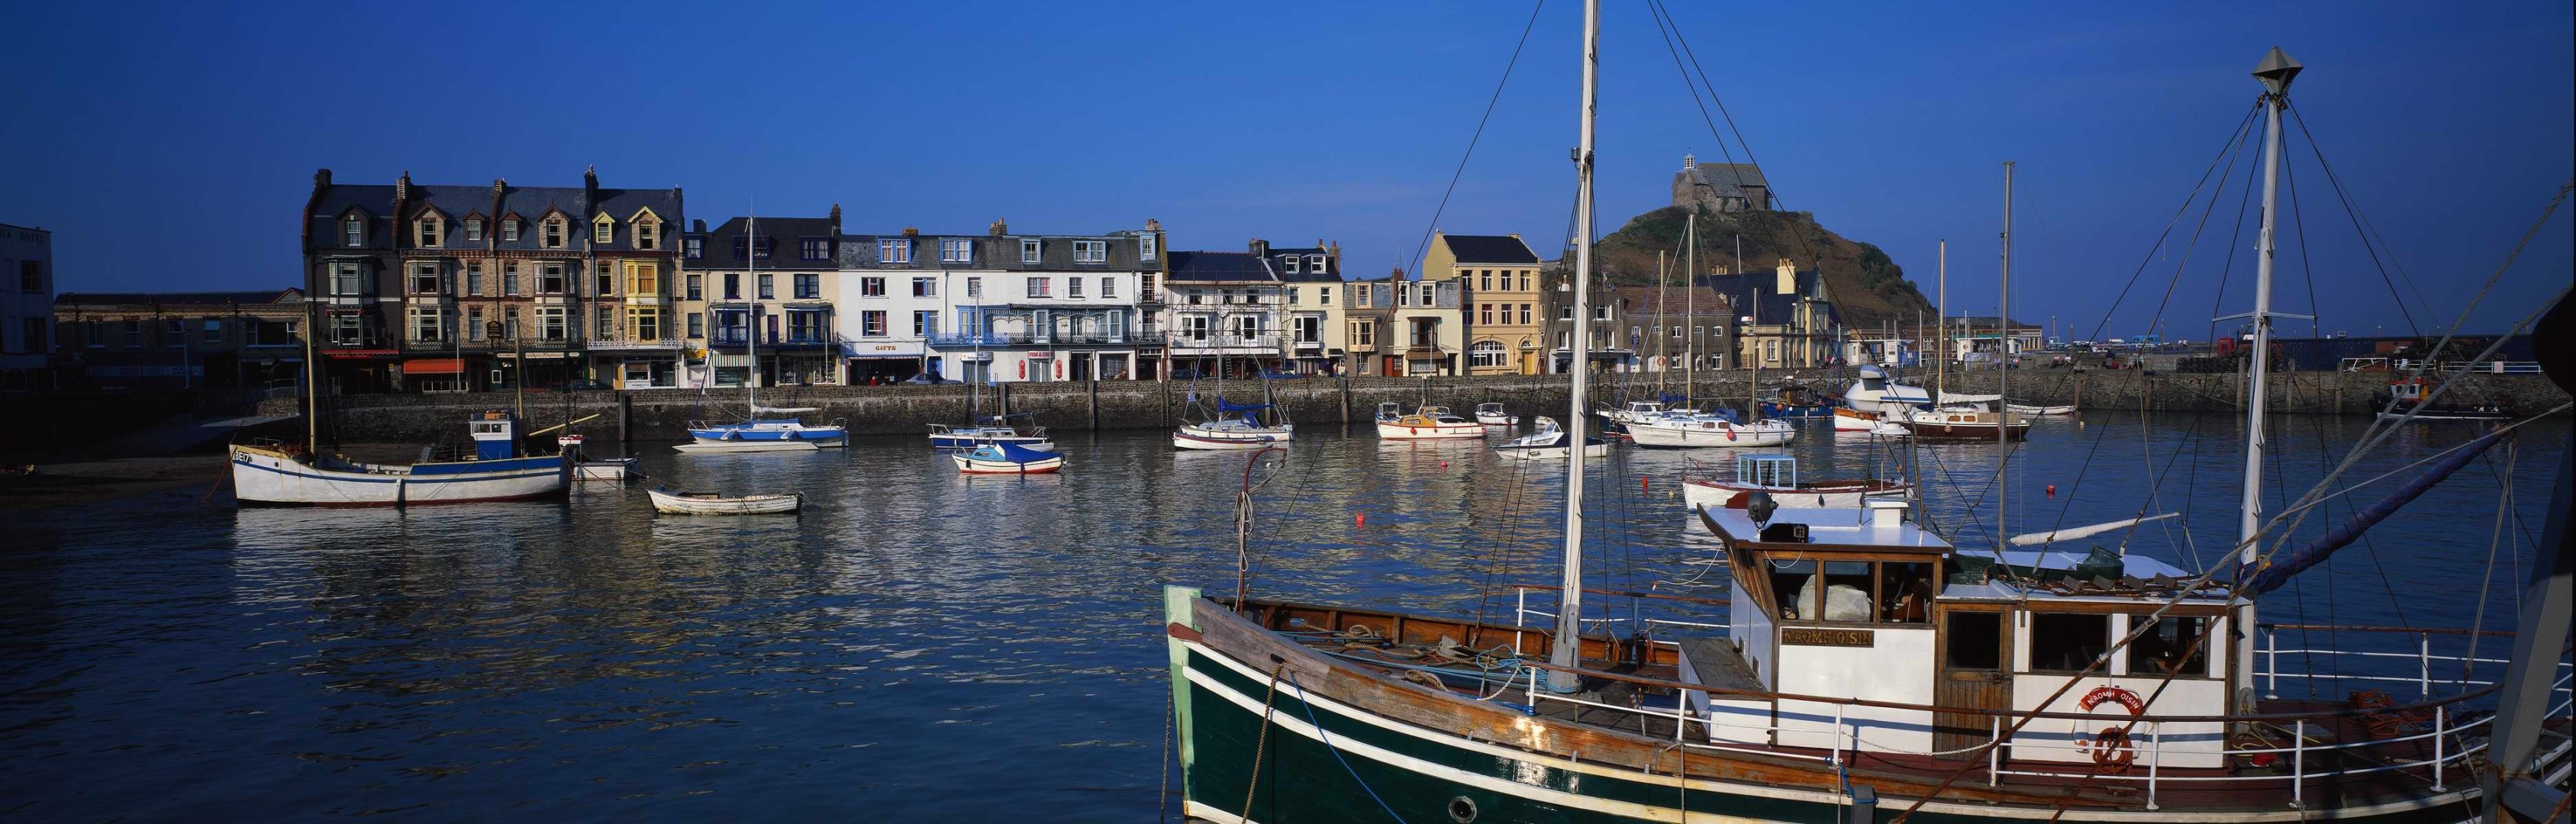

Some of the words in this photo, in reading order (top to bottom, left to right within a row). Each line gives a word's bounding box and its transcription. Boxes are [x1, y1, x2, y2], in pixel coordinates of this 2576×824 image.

[20, 231, 43, 244] HOTEL
[1782, 630, 1831, 645] NAOMH
[1835, 632, 1872, 646] OISIN
[2088, 691, 2115, 705] NAOMH
[2120, 694, 2139, 709] OISIN
